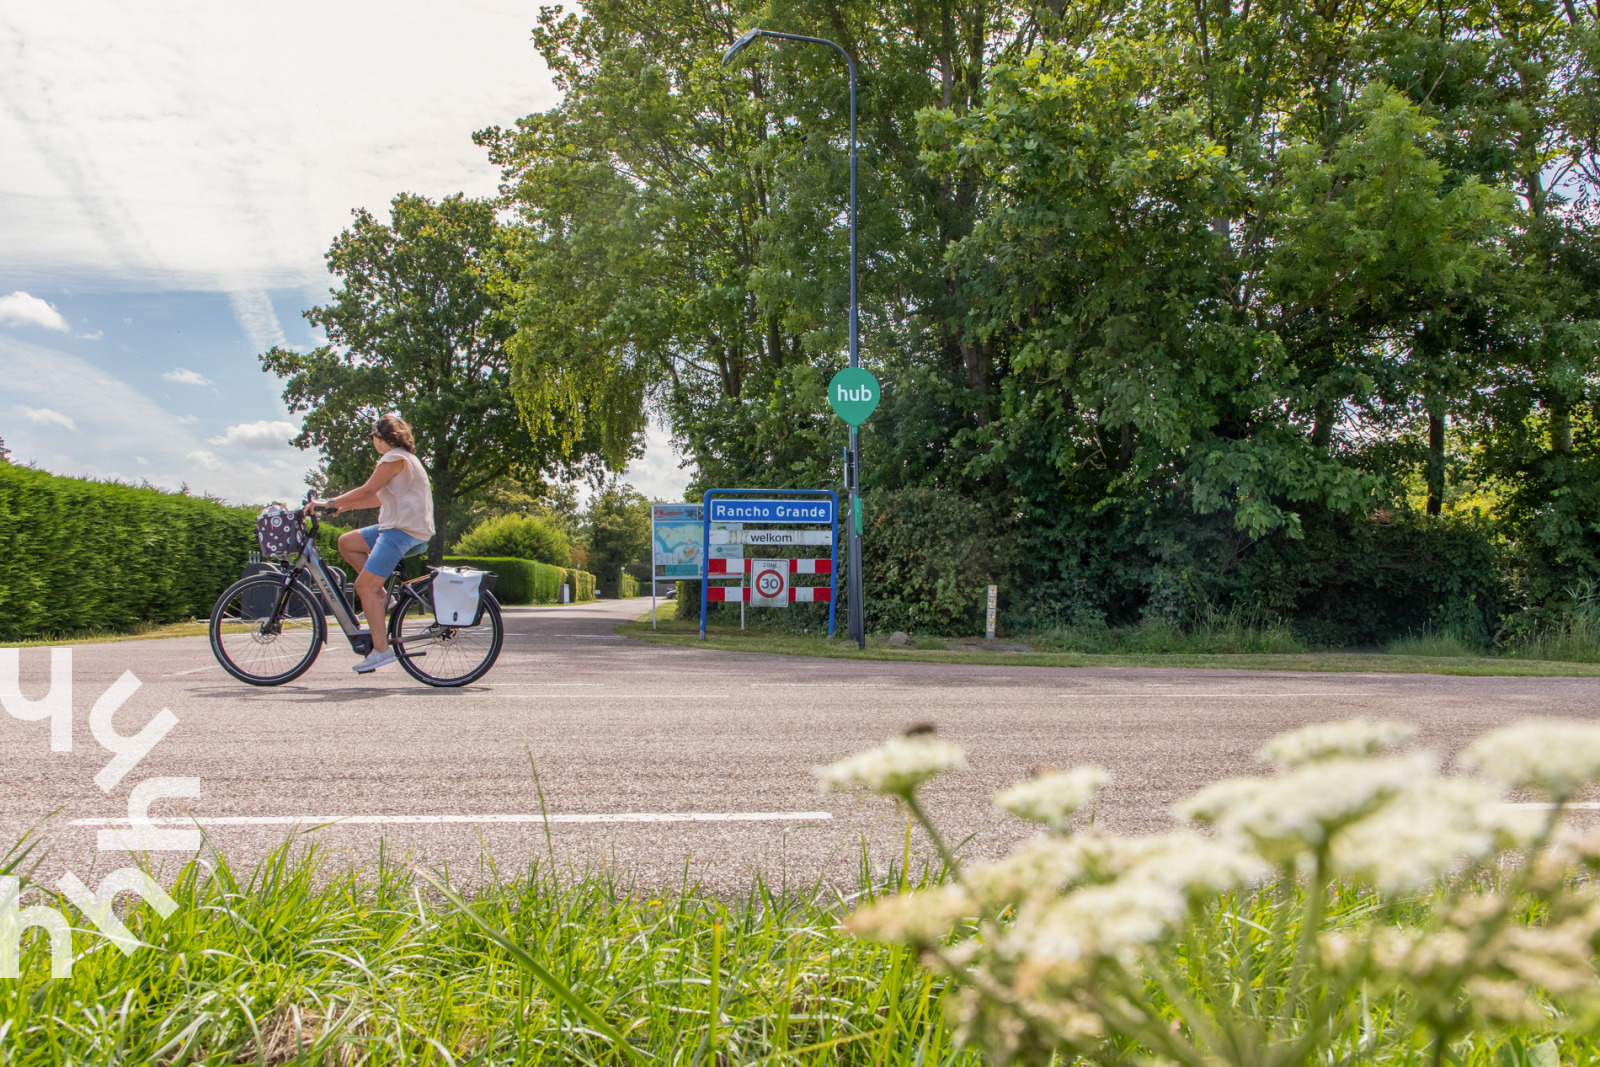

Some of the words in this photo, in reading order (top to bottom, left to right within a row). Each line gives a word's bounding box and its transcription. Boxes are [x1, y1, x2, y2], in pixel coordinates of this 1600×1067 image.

[837, 384, 872, 401] hub
[716, 505, 770, 517] Rancho
[776, 506, 826, 517] Grande
[750, 533, 792, 542] welkom
[760, 578, 779, 589] 30
